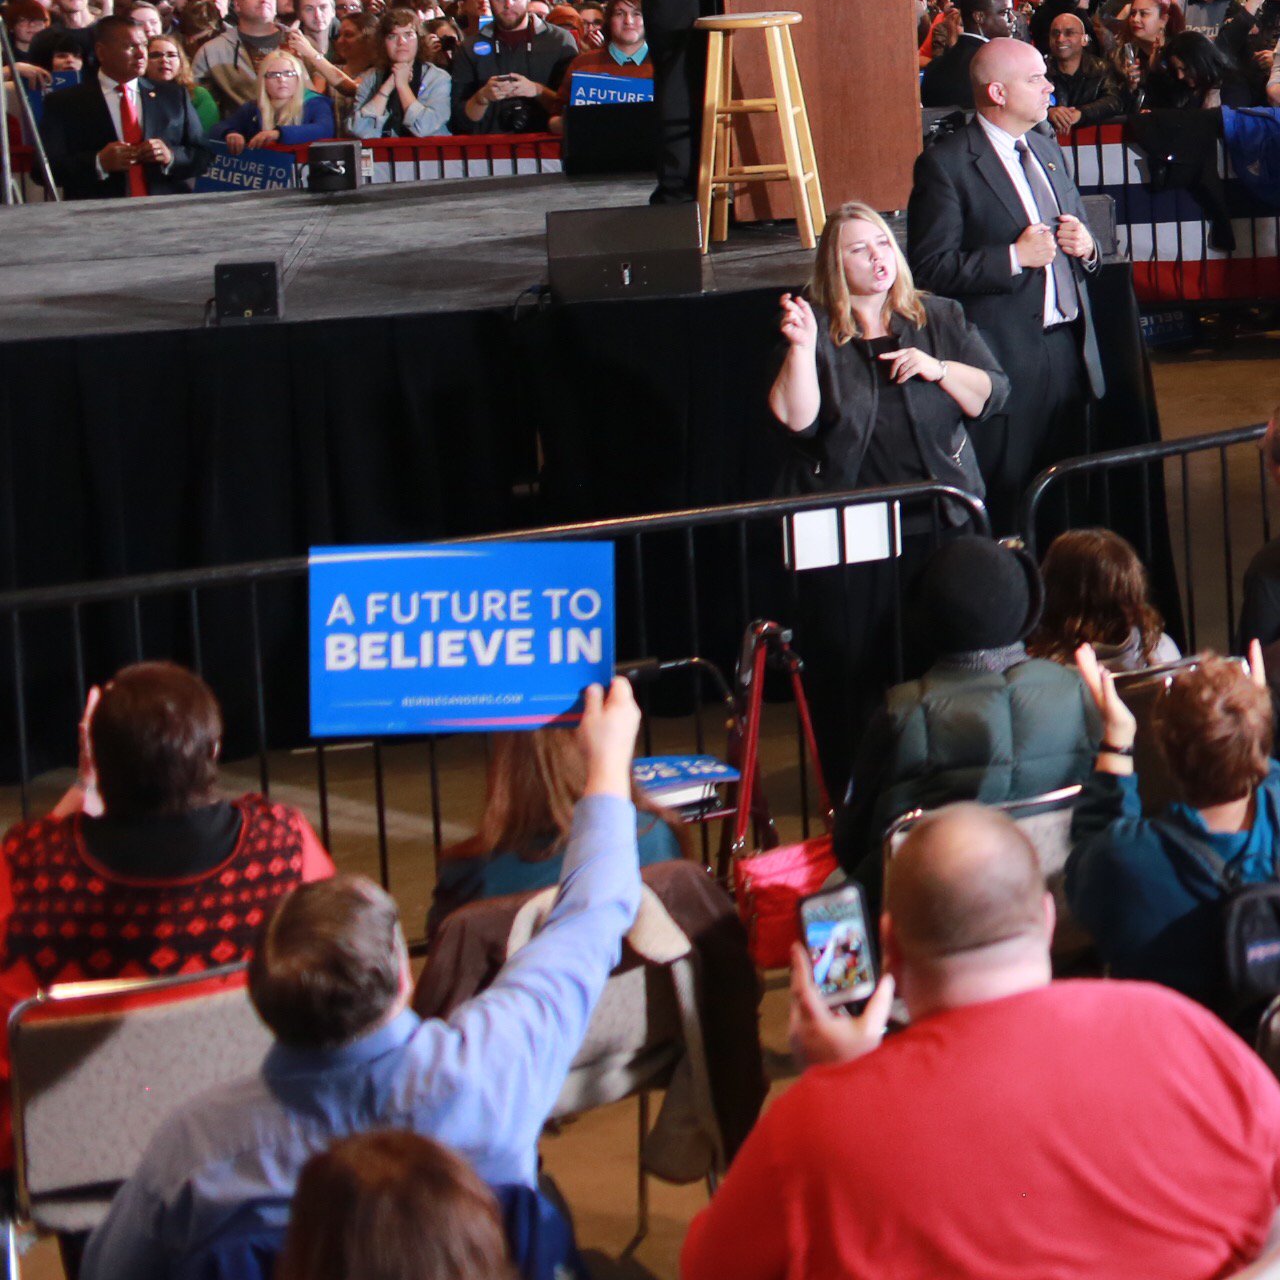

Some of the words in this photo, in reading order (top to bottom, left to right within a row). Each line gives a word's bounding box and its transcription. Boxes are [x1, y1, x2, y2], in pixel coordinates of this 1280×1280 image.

[576, 86, 585, 97] A
[589, 87, 645, 103] FUTURE
[202, 167, 262, 190] ELIEVE
[215, 154, 265, 175] FUTURE
[268, 166, 286, 179] TO
[325, 593, 356, 626] A
[366, 589, 533, 625] FUTURE
[541, 588, 602, 621] TO
[325, 628, 536, 671] BELIEVE
[549, 627, 603, 665] IN
[401, 693, 524, 707] BERNIESANDERS.COM
